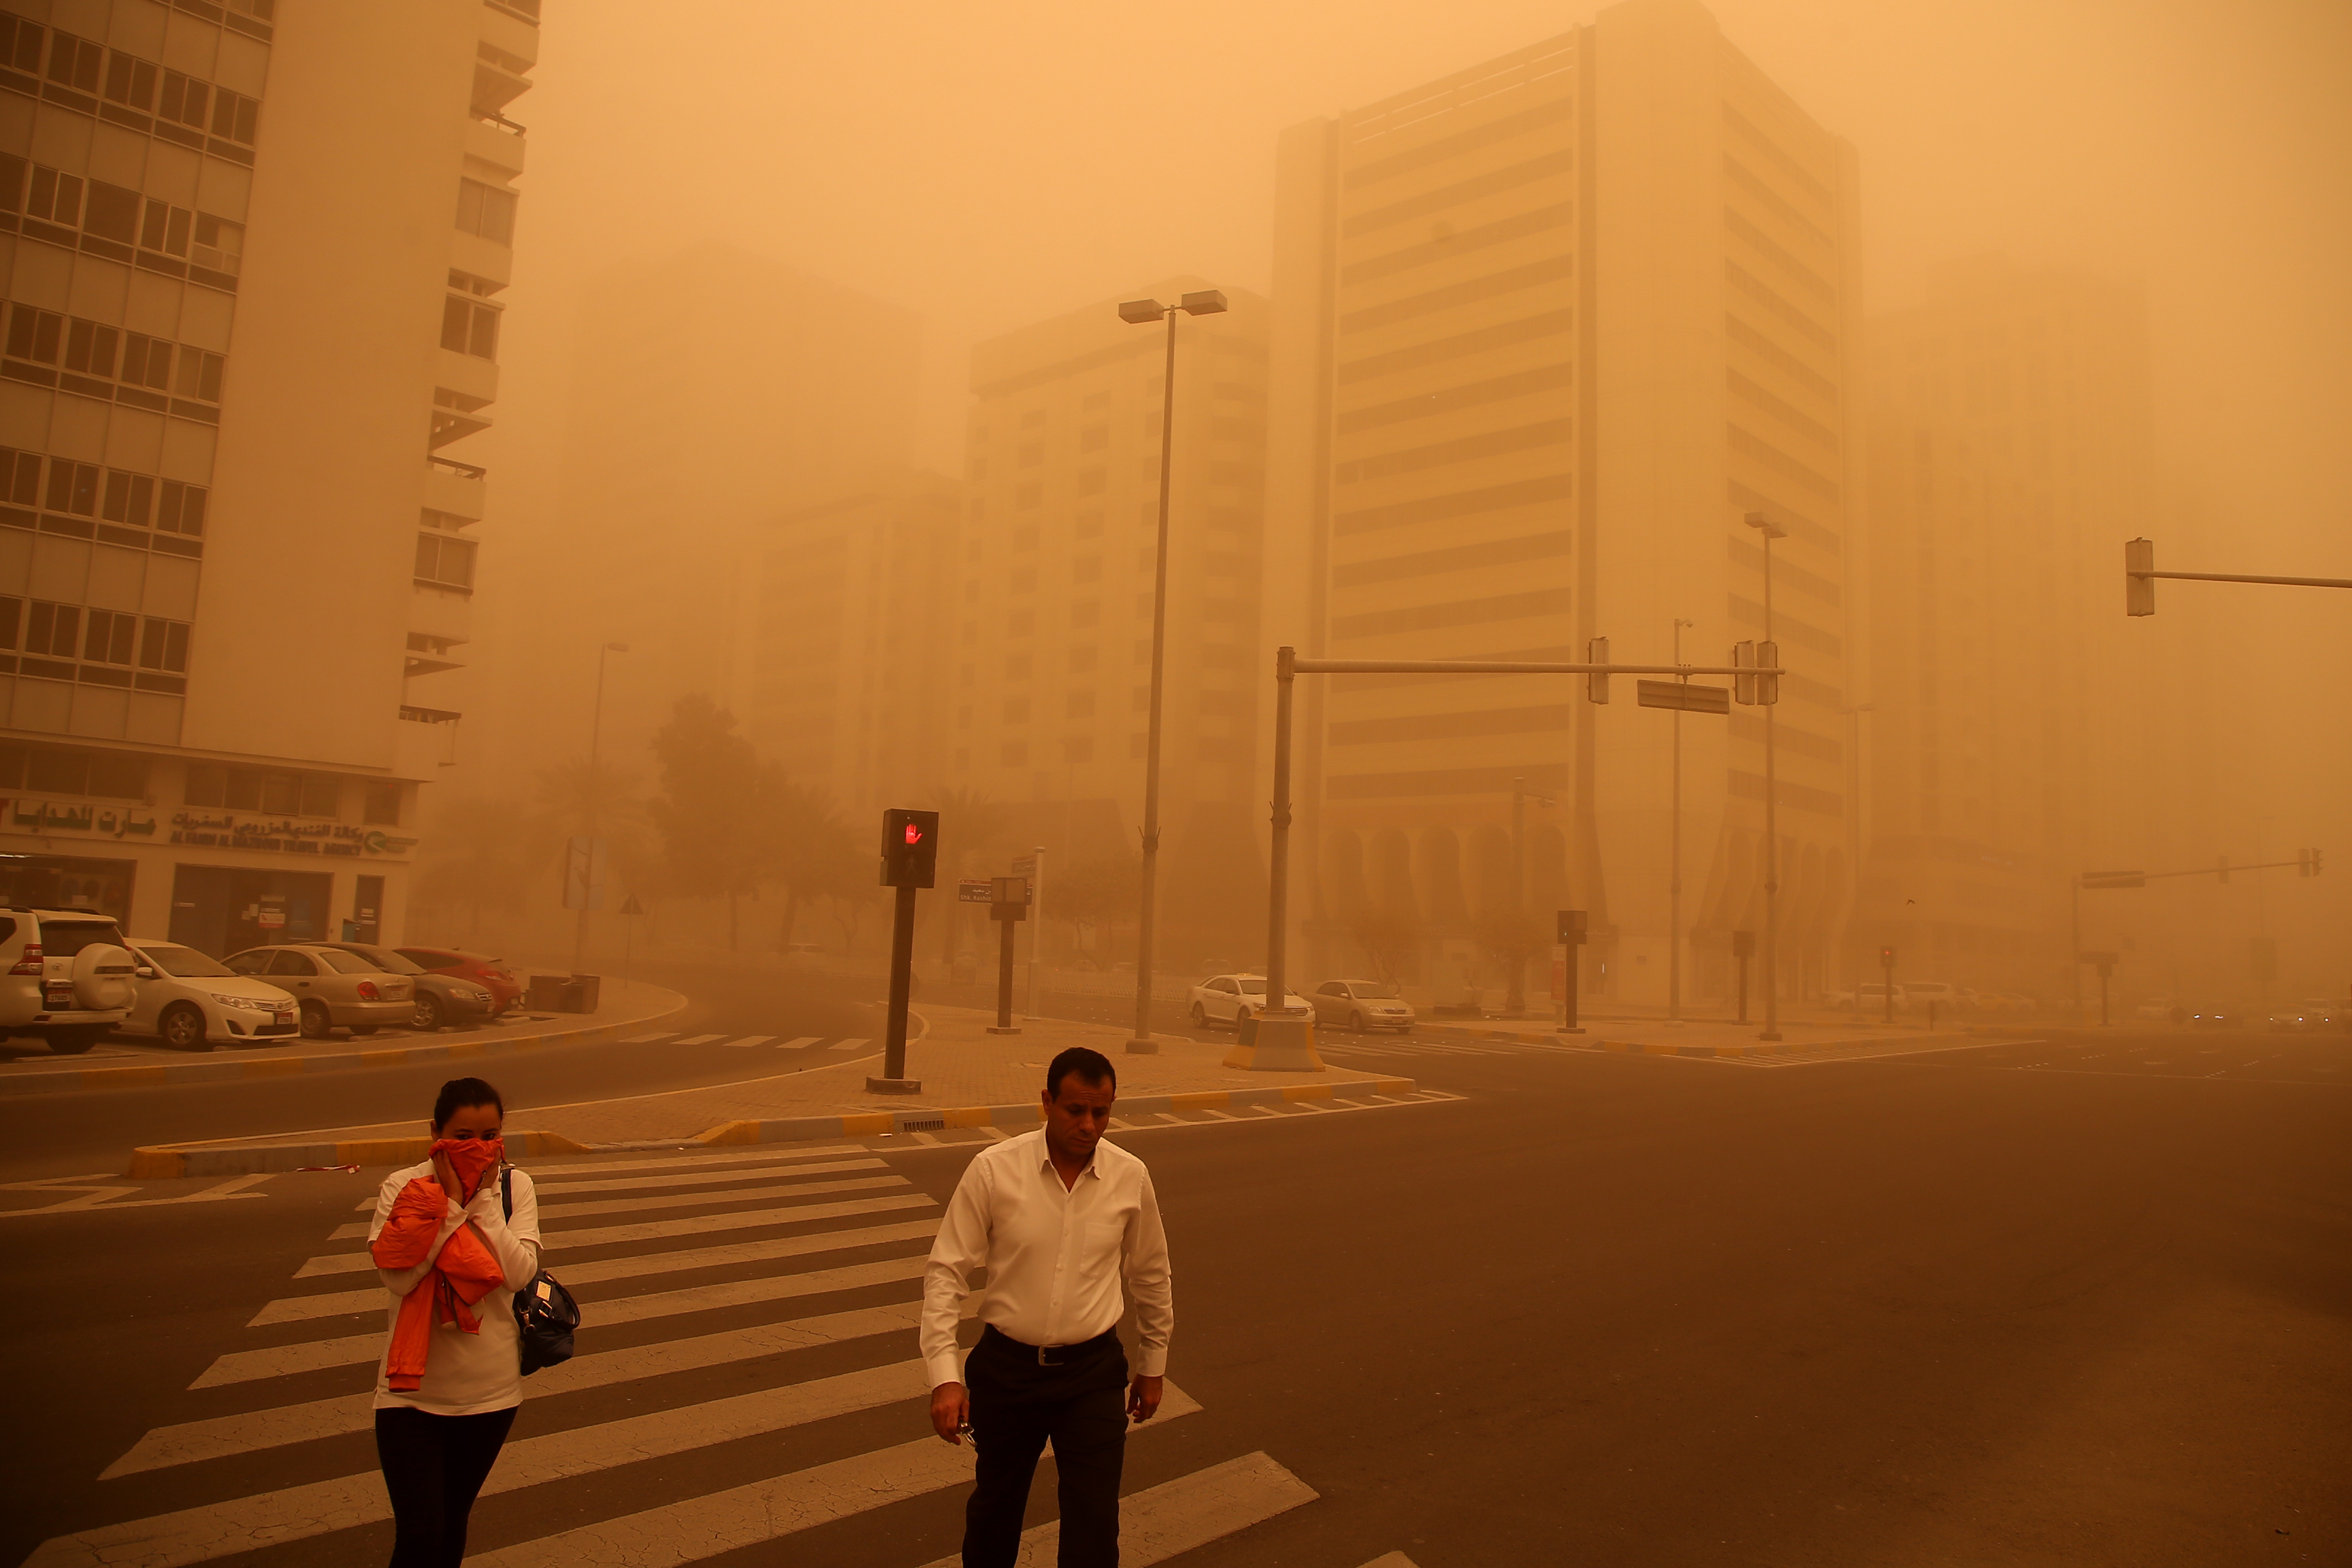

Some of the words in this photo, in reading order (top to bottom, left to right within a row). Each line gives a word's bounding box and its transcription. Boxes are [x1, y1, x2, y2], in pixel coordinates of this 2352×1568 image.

[170, 831, 184, 843] AL
[218, 834, 231, 847] AL
[284, 839, 320, 853] TRAVEL
[323, 843, 362, 856] AGENCY
